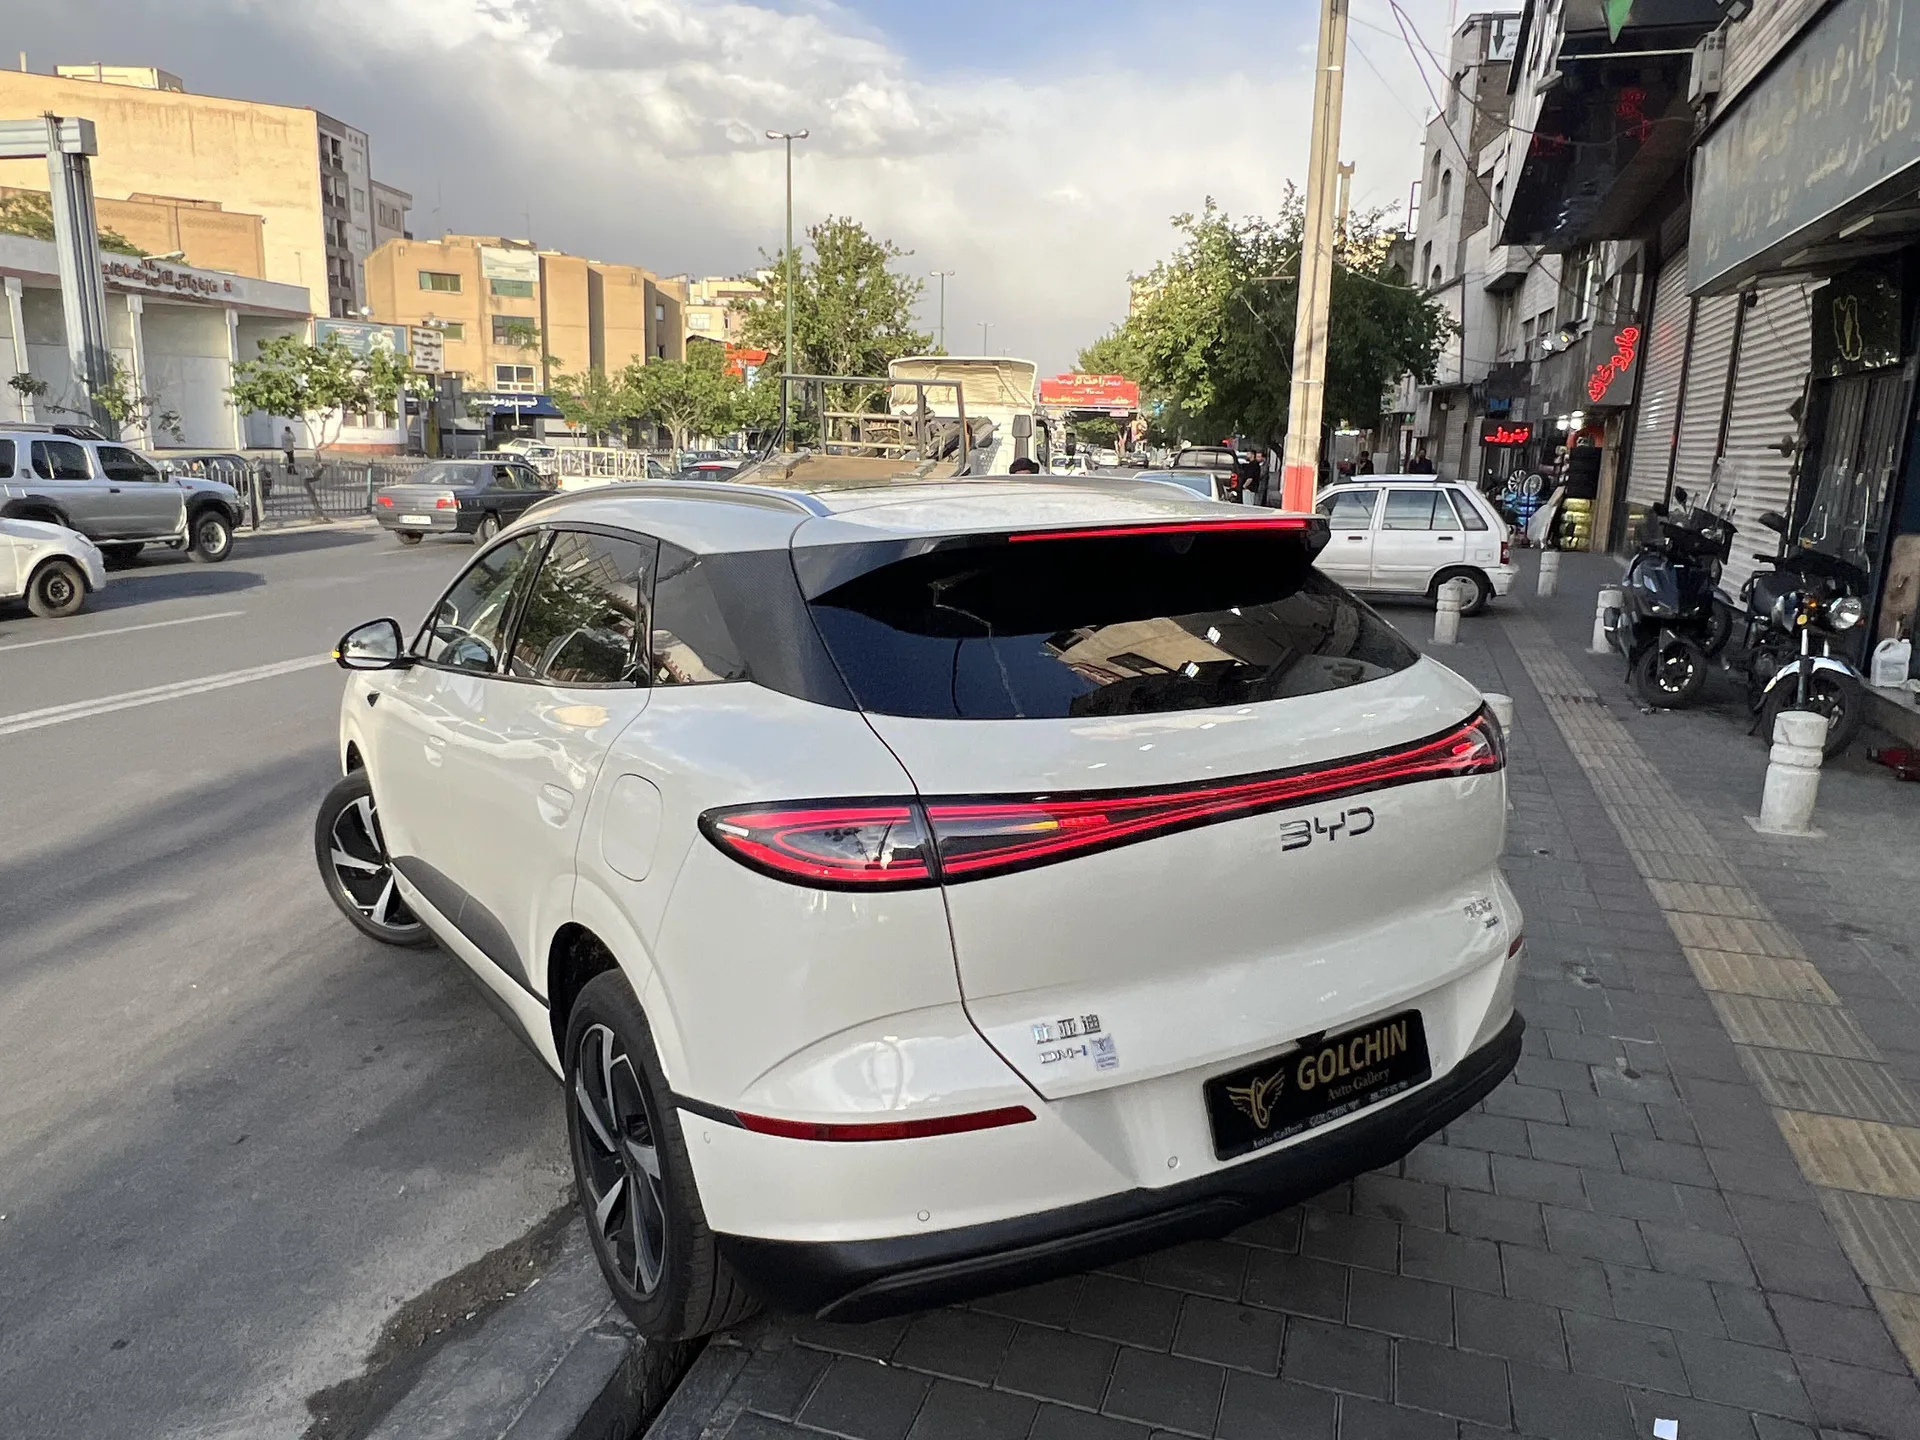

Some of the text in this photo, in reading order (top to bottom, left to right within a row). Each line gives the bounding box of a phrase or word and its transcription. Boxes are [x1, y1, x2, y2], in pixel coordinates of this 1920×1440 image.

[1280, 806, 1374, 851] BYD
[1297, 1020, 1407, 1091] GOLCHIN
[1327, 1084, 1352, 1101] Auto
[1353, 1068, 1390, 1090] Gallery
